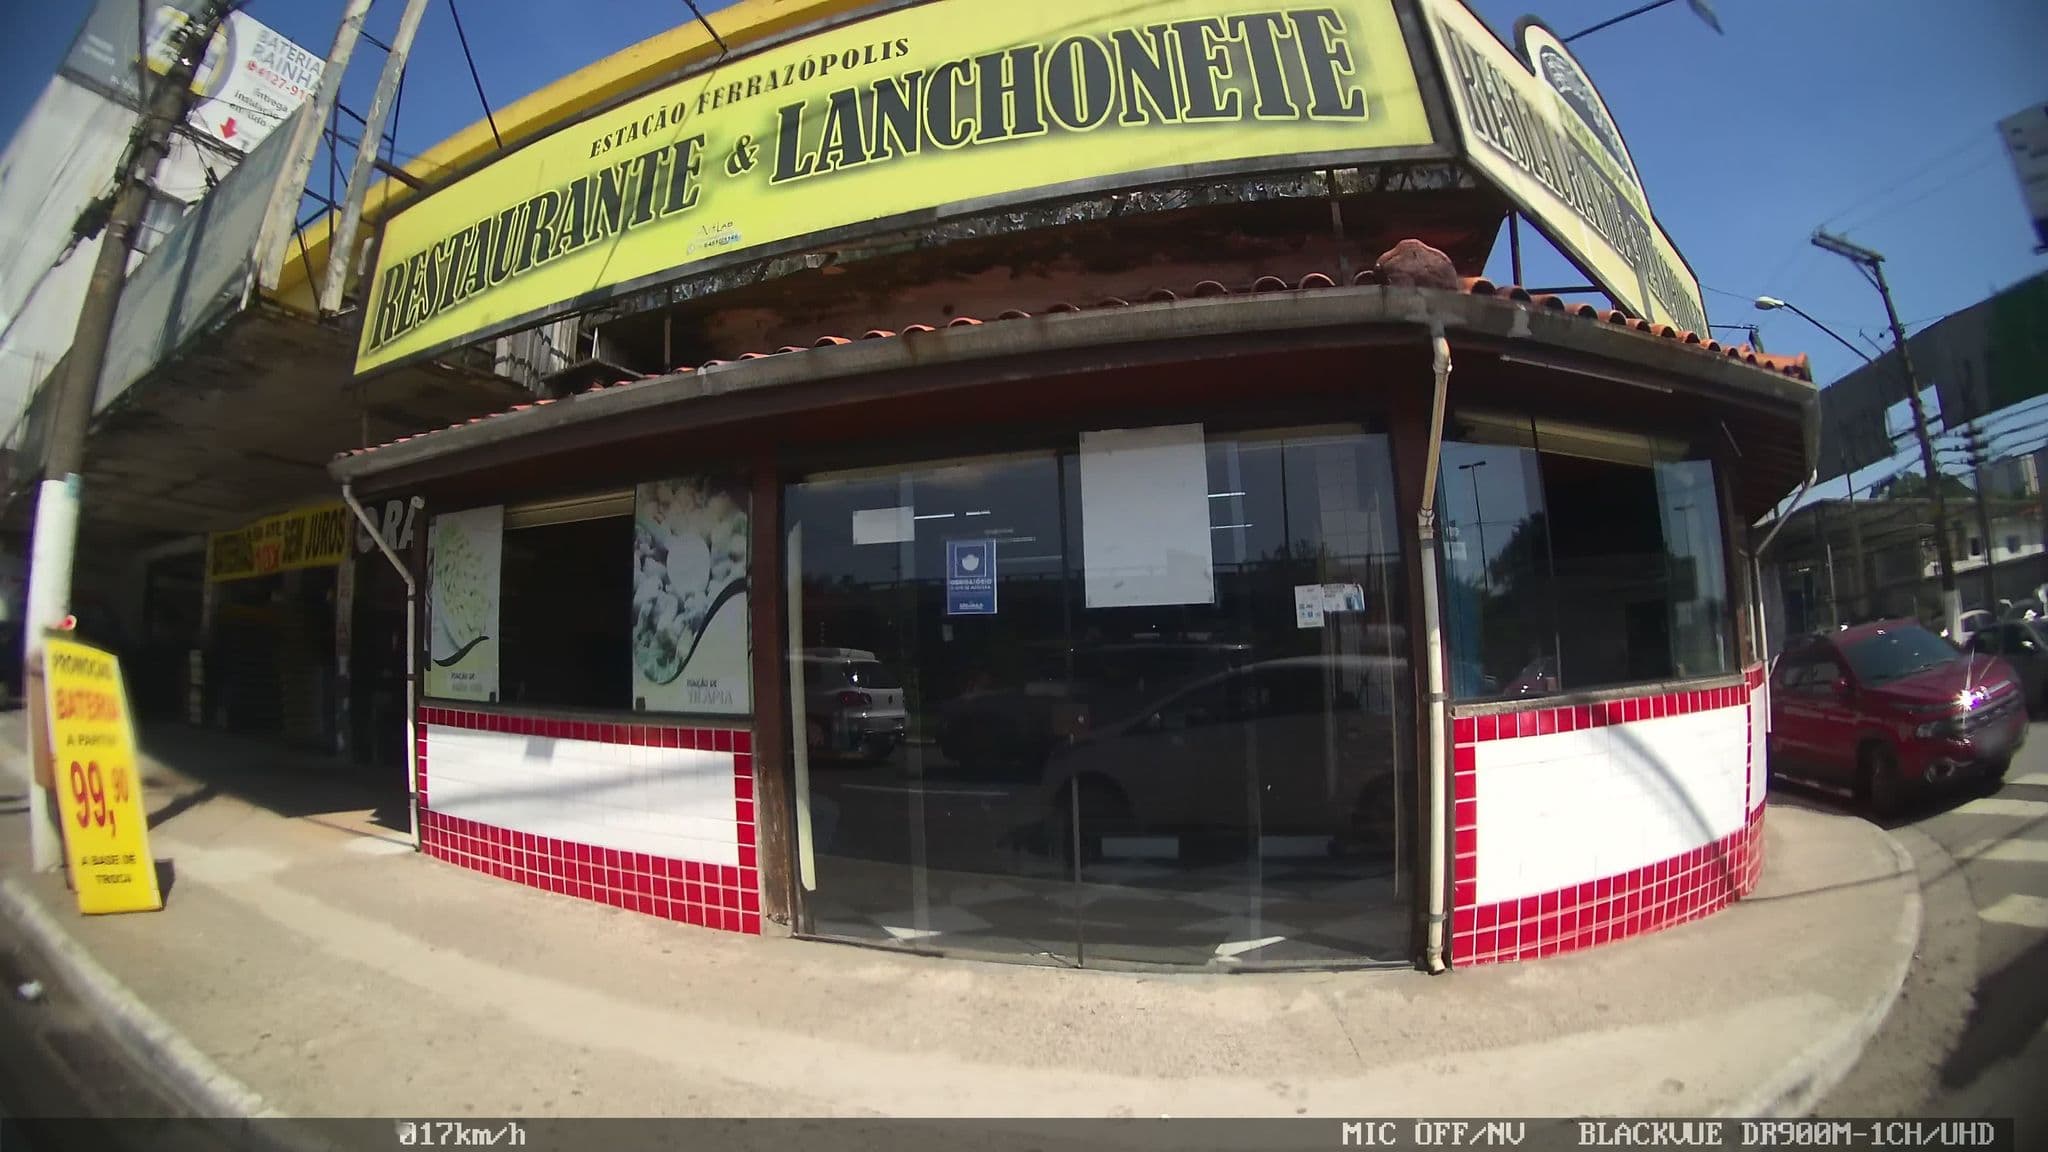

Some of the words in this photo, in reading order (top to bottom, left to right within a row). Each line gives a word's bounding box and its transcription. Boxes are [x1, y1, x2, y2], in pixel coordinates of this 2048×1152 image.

[368, 131, 706, 353] RESTAURANTE
[725, 133, 761, 176] &
[769, 7, 1370, 185] LANCHONETE
[589, 101, 686, 159] ESTAÇÃO
[695, 37, 910, 115] FERRAZÓPOLIS
